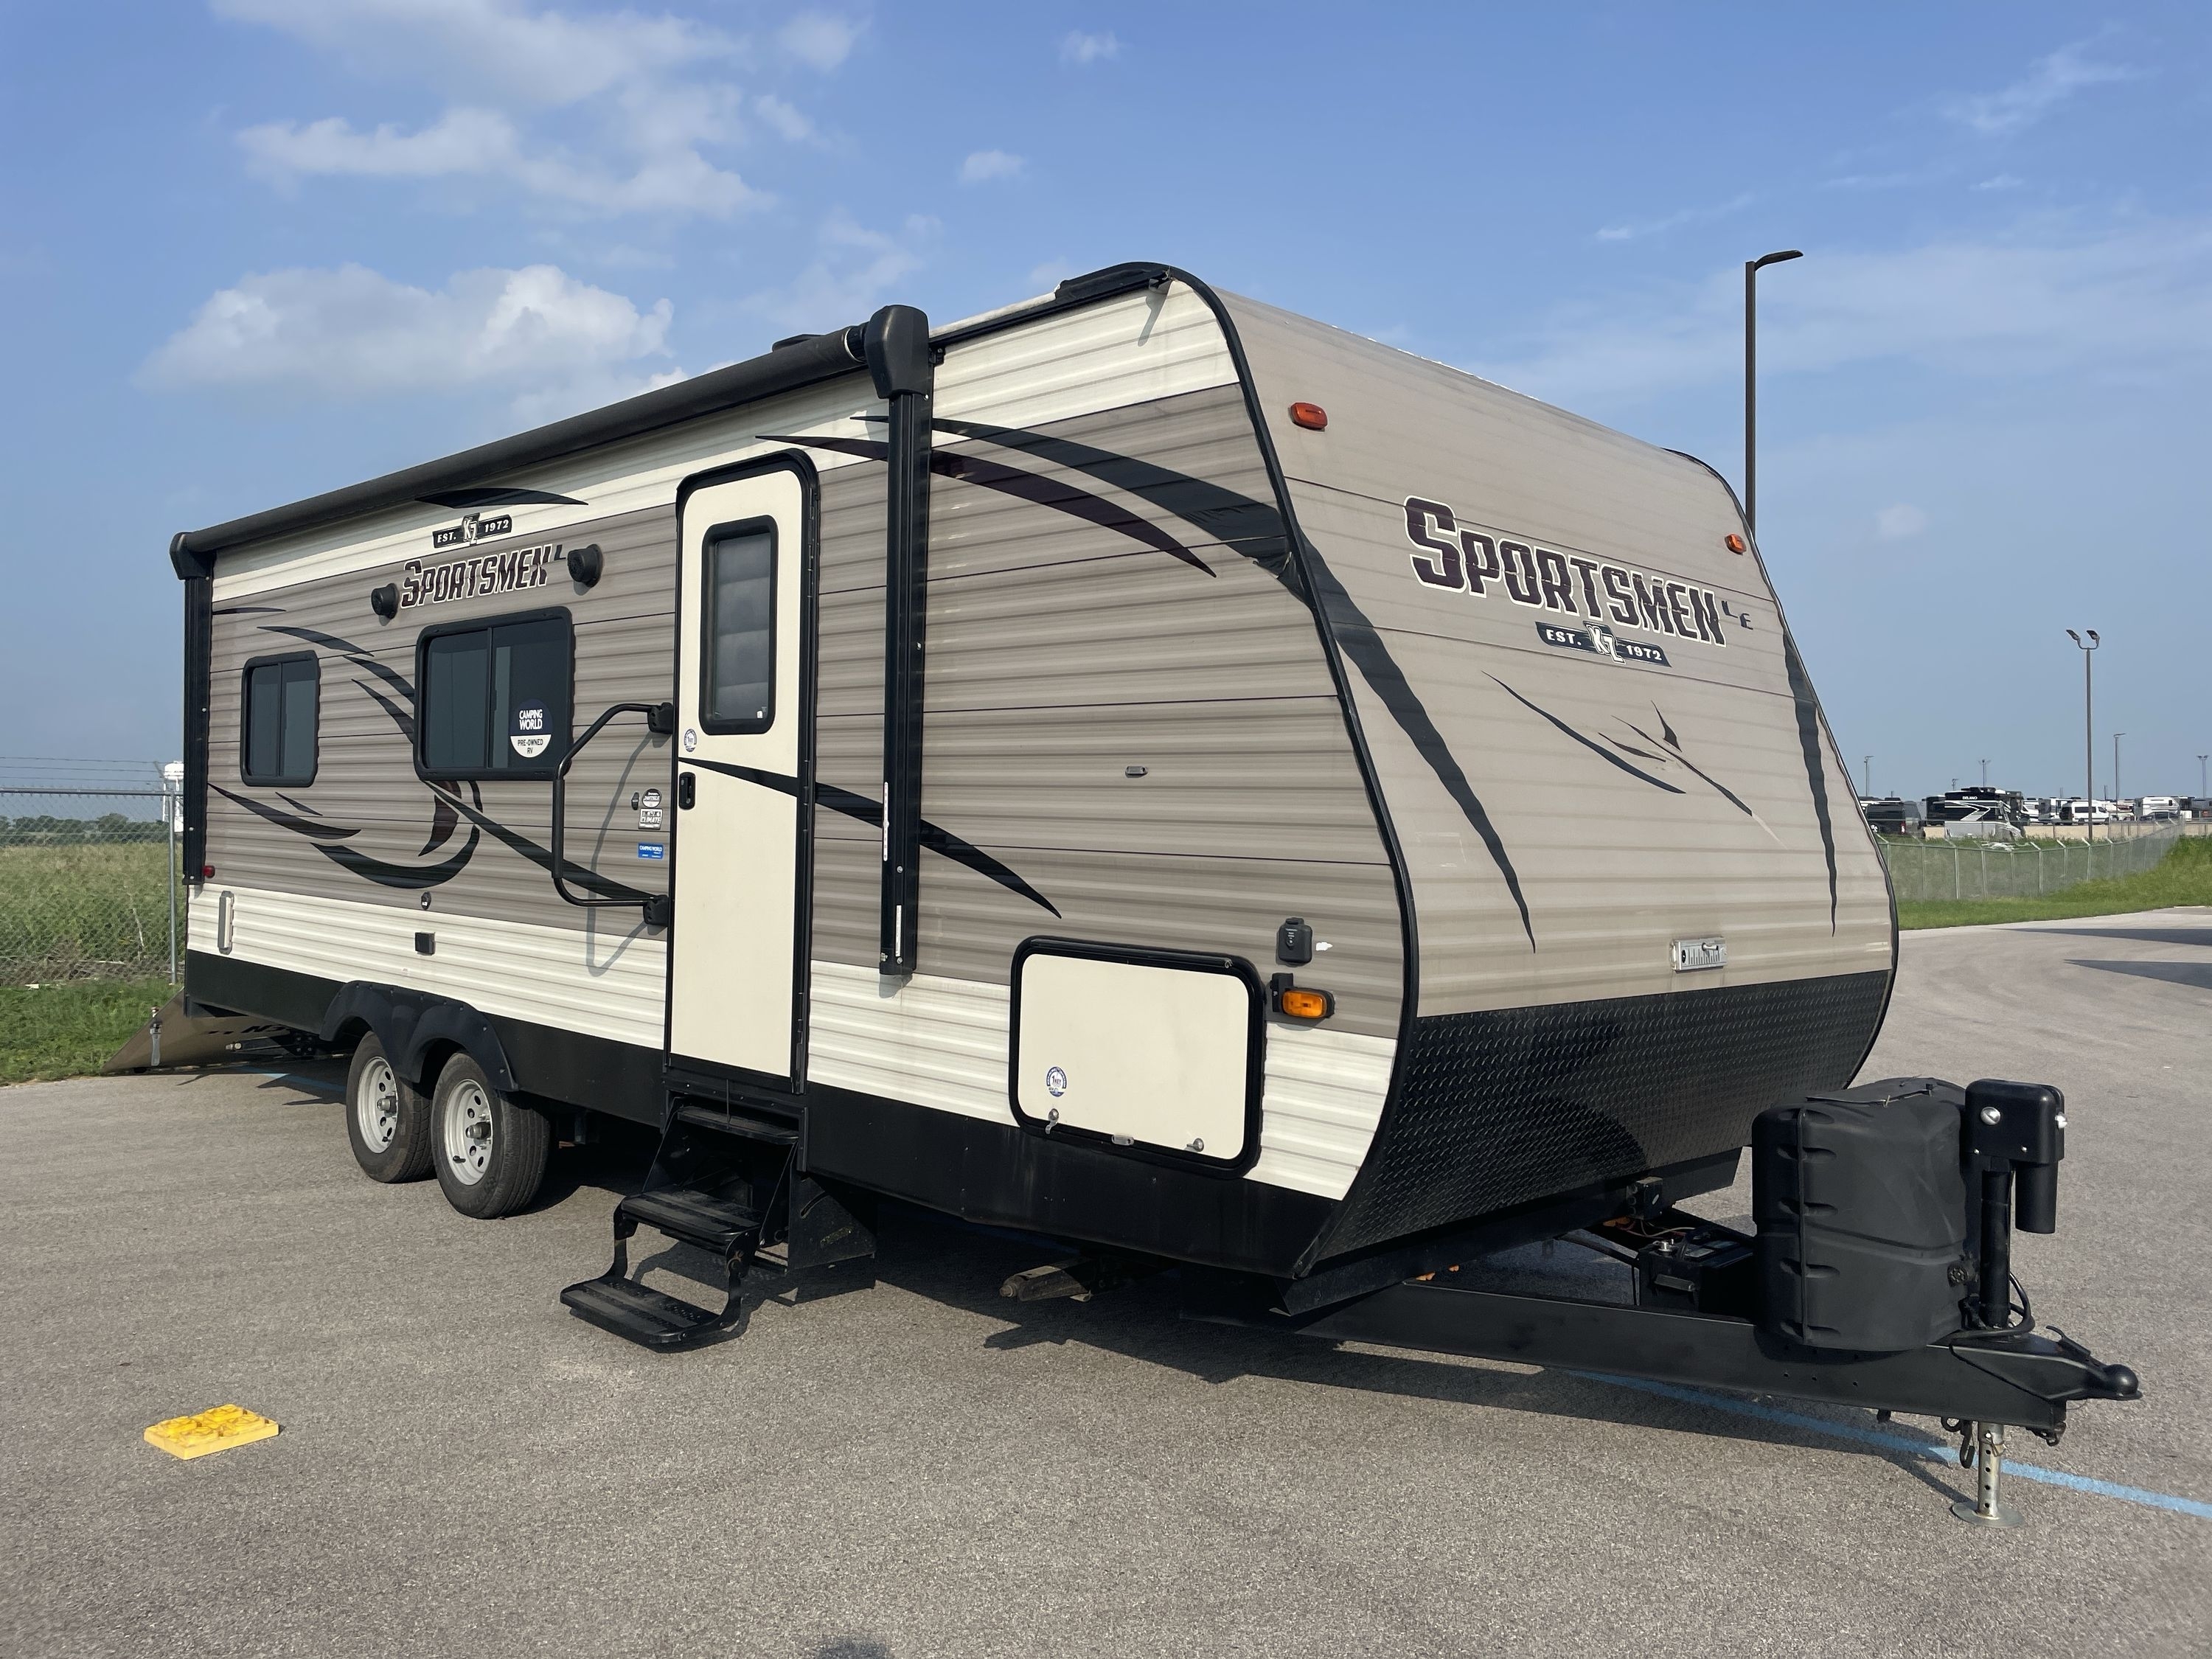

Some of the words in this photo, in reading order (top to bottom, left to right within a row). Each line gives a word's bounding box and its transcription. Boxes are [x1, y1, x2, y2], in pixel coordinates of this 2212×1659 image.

[437, 532, 456, 543] EST.
[484, 519, 509, 533] 1972
[400, 543, 553, 609] SPORTSMEN
[1403, 495, 1726, 647] SPORTSMEN
[1545, 629, 1582, 646] EST.
[1626, 644, 1663, 661] 1972
[519, 709, 543, 720] CAMPING
[519, 718, 543, 730] WORLD
